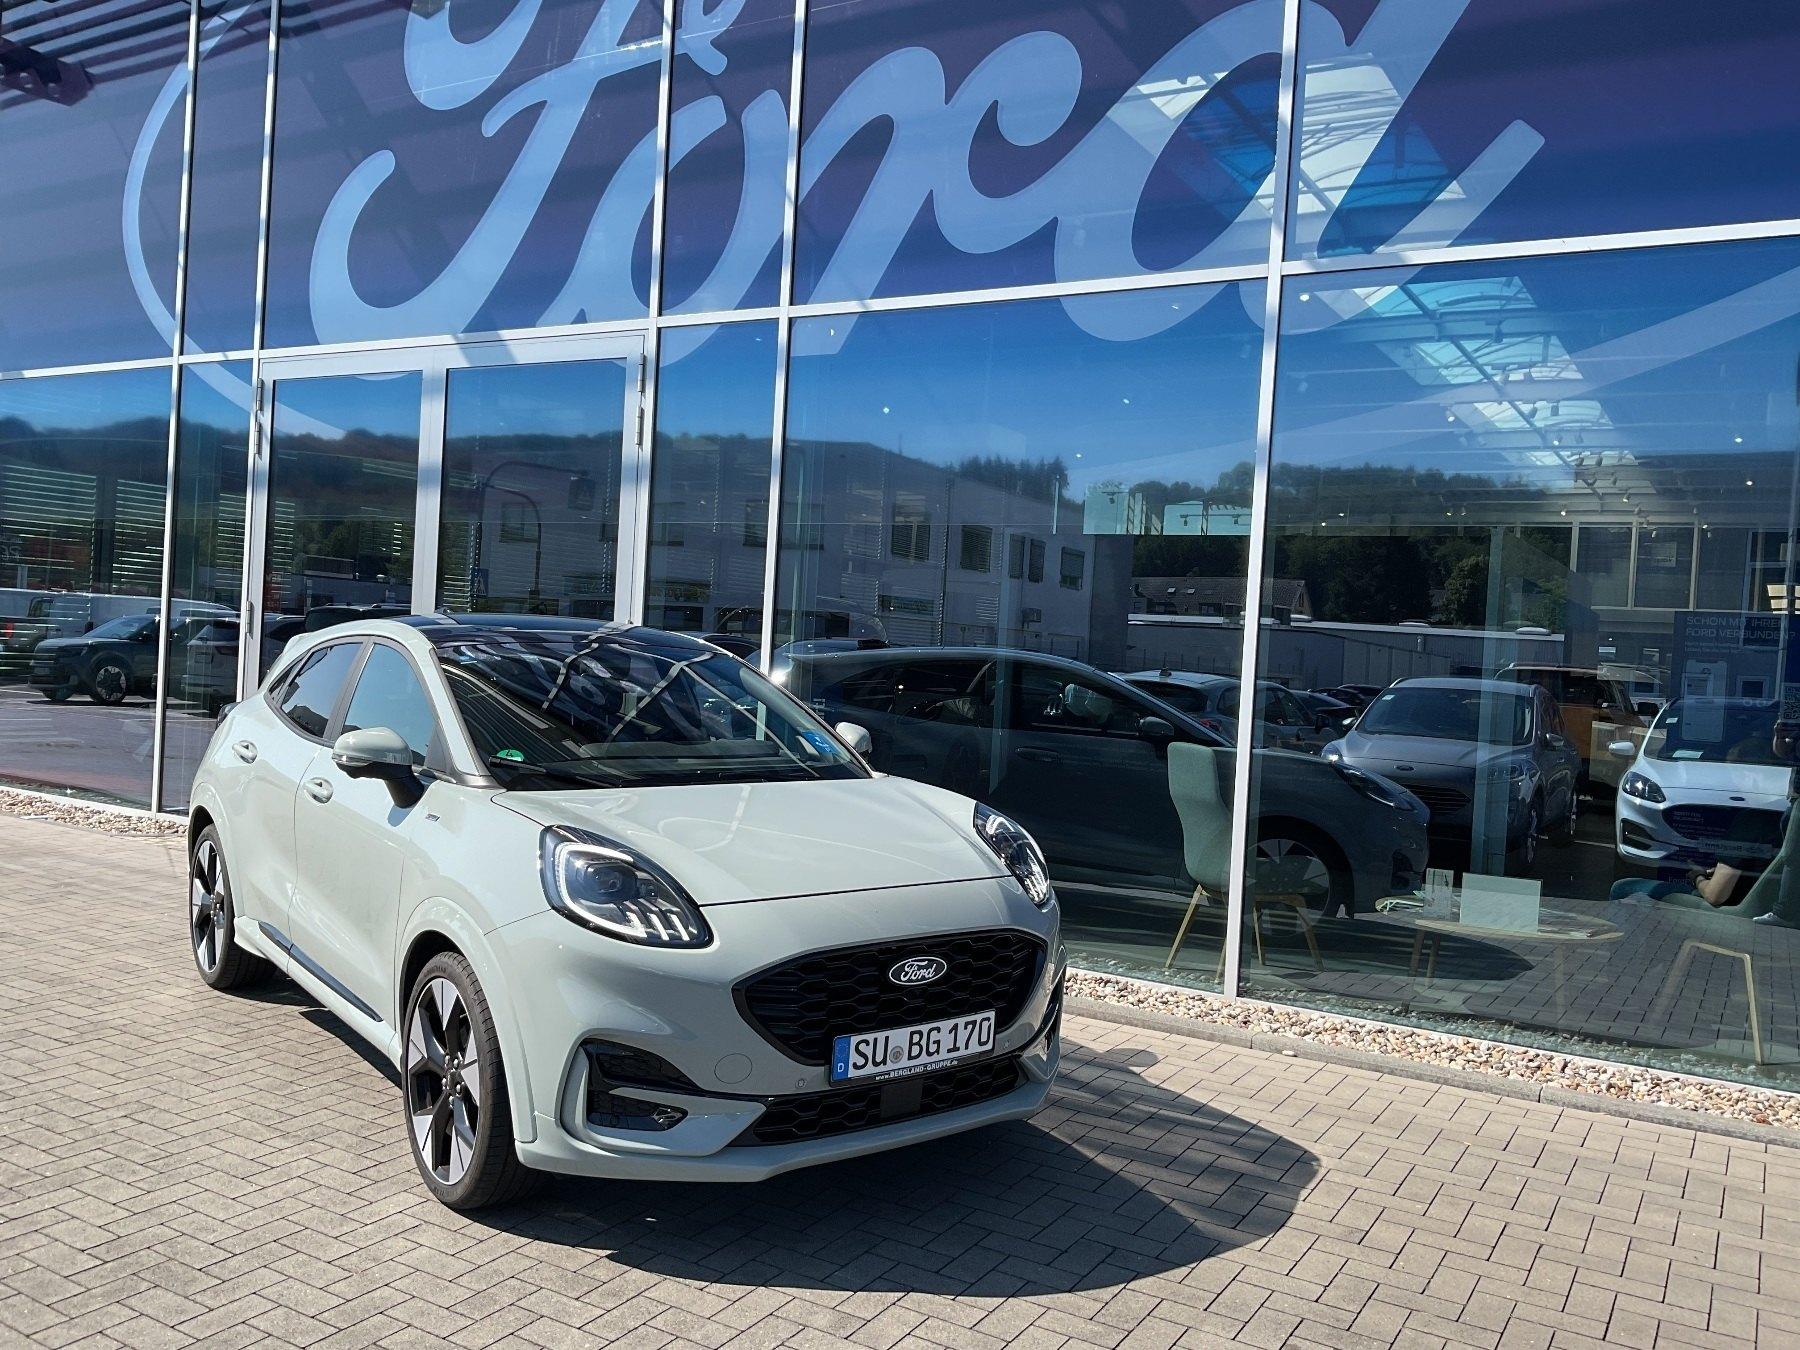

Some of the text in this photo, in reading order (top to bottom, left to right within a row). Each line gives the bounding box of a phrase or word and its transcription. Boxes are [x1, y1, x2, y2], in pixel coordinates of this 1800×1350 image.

[309, 0, 1546, 380] Ford
[1686, 616, 1726, 626] SCHON
[1686, 627, 1717, 637] FORD
[900, 960, 937, 982] Ford
[852, 1016, 992, 1071] SU BG 170
[837, 1062, 845, 1073] D
[875, 1059, 958, 1081] www.BERGLAND-GRUPPE.de
